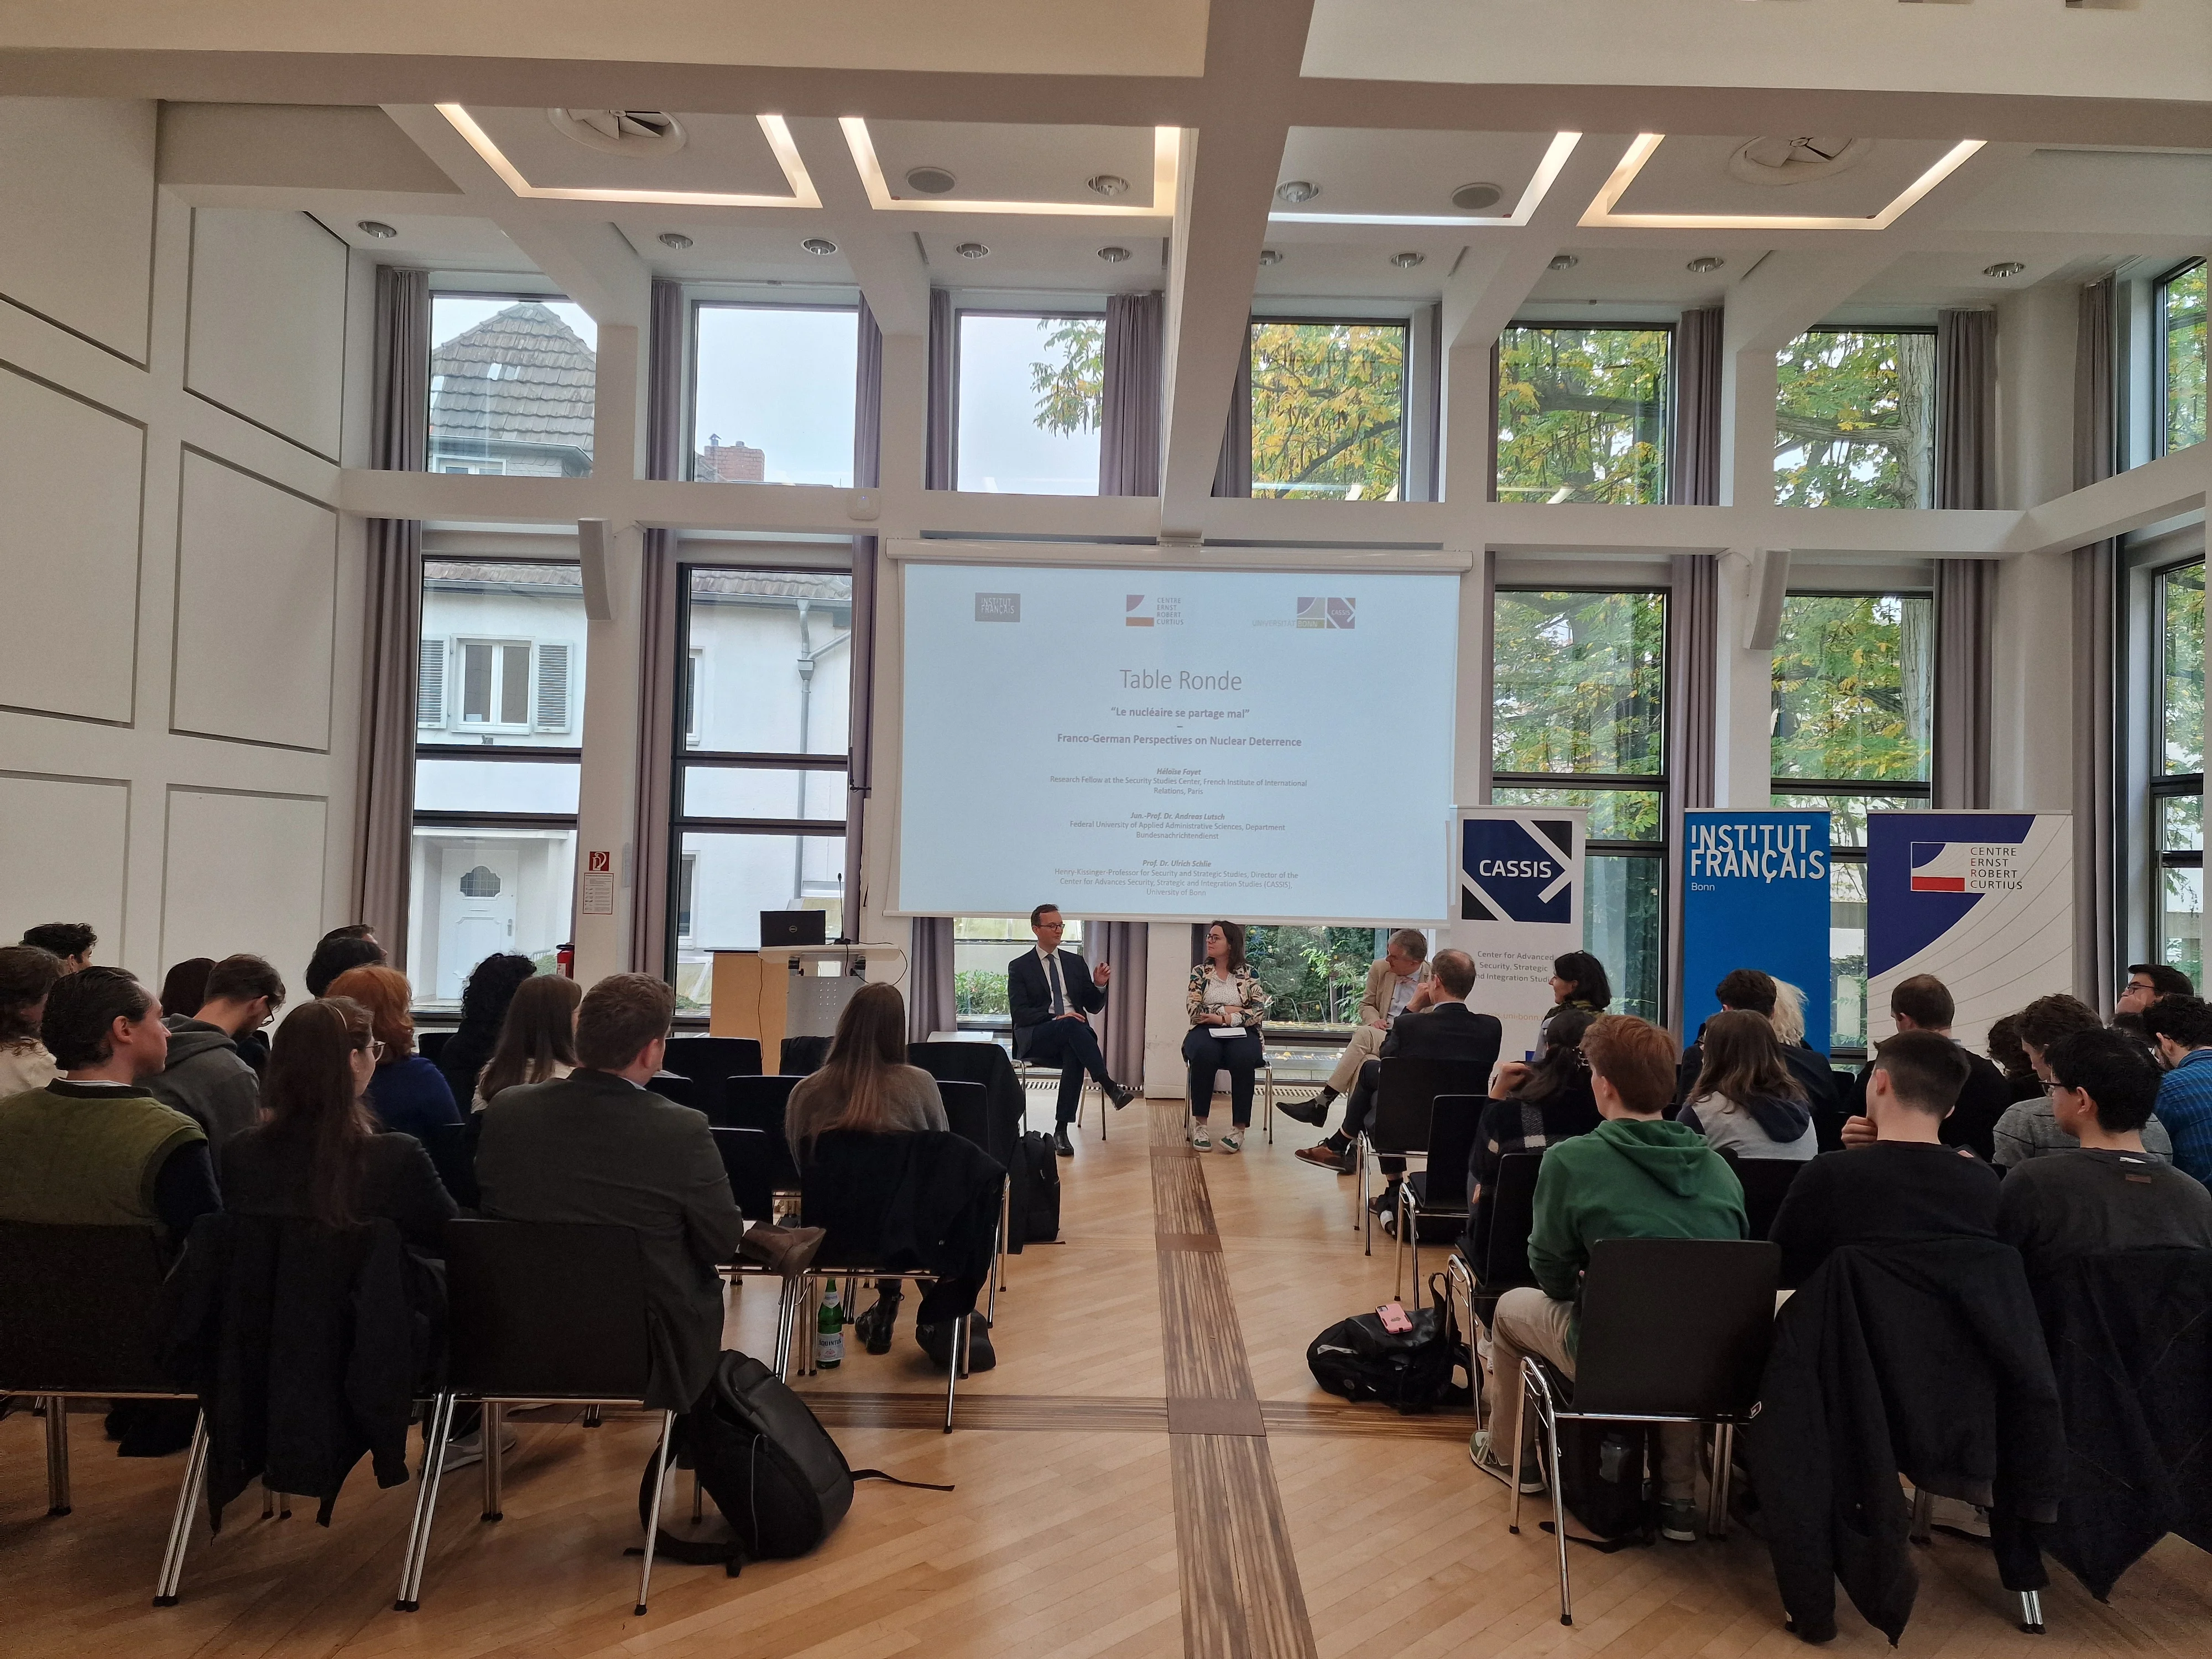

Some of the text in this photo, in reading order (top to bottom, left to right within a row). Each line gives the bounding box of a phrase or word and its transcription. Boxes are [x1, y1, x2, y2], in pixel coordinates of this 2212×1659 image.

[981, 597, 1011, 606] INSTITUT
[981, 605, 1015, 615] FRANÇAIS
[1119, 669, 1243, 691] Table Ronde
[1129, 707, 1173, 717] nucléaire
[1188, 709, 1225, 720] partage
[1057, 733, 1131, 744] Franco-German
[1133, 735, 1193, 746] Perspectives
[1209, 736, 1246, 745] Nuclear
[1249, 737, 1302, 747] Deterrence
[1182, 768, 1202, 776] Fayet
[1125, 777, 1152, 785] Security
[1178, 778, 1202, 786] Center,
[1154, 787, 1186, 795] Relations,
[1130, 812, 1162, 821] Jun.-Prof.
[1095, 821, 1129, 829] University
[1245, 823, 1286, 832] Department
[1136, 831, 1219, 839] Bundesnachrichtendienst
[1691, 825, 1811, 853] INSTITUT
[1970, 847, 2017, 856] CENTRE
[1142, 859, 1158, 868] Prof.
[1691, 849, 1825, 884] FRANÇAIS
[1970, 858, 2008, 867] ERNST
[1054, 868, 1139, 877] Henry-Kissinger-Professor
[1151, 869, 1178, 878] Security
[1479, 859, 1552, 878] CASSIS
[1970, 869, 2018, 879] ROBERT
[1127, 879, 1155, 887] Security,
[1157, 879, 1185, 888] Strategic
[1201, 880, 1237, 888] Integration
[1264, 881, 1293, 889] (CASSIS),
[1691, 882, 1715, 891] Bonn
[1970, 880, 2023, 890] CURTIUS
[1146, 888, 1179, 896] University
[1517, 953, 1554, 961] Advanced
[1479, 962, 1548, 972] Security, Strategic
[1486, 973, 1528, 982] Integration
